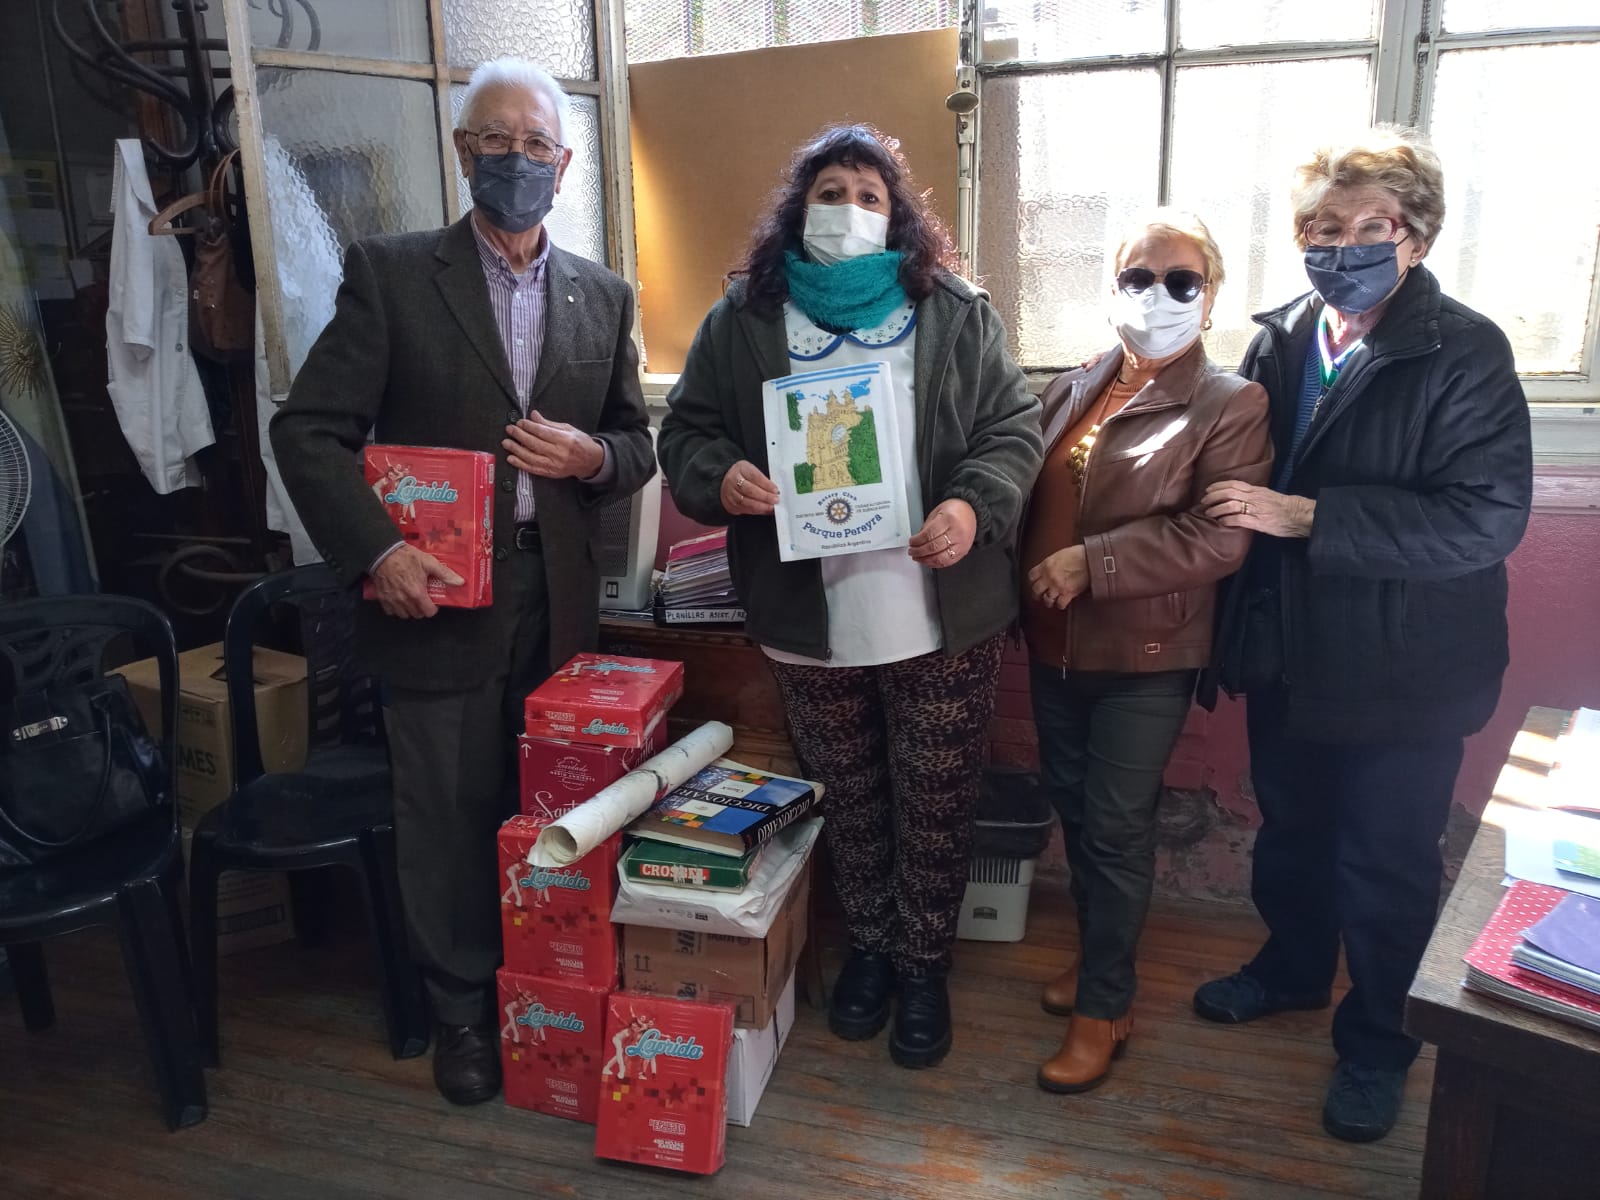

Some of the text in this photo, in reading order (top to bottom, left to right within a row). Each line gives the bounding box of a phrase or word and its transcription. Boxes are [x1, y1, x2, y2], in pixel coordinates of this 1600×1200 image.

[385, 476, 457, 505] Laprida
[842, 491, 858, 502] Club
[803, 513, 883, 539] Parque Pereyra
[667, 610, 705, 620] PLANILLAS
[177, 746, 217, 776] MES
[672, 788, 771, 813] DICCIONARI
[519, 866, 591, 891] Laprida
[516, 1003, 585, 1032] Laprida
[625, 1028, 704, 1061] Laprida
